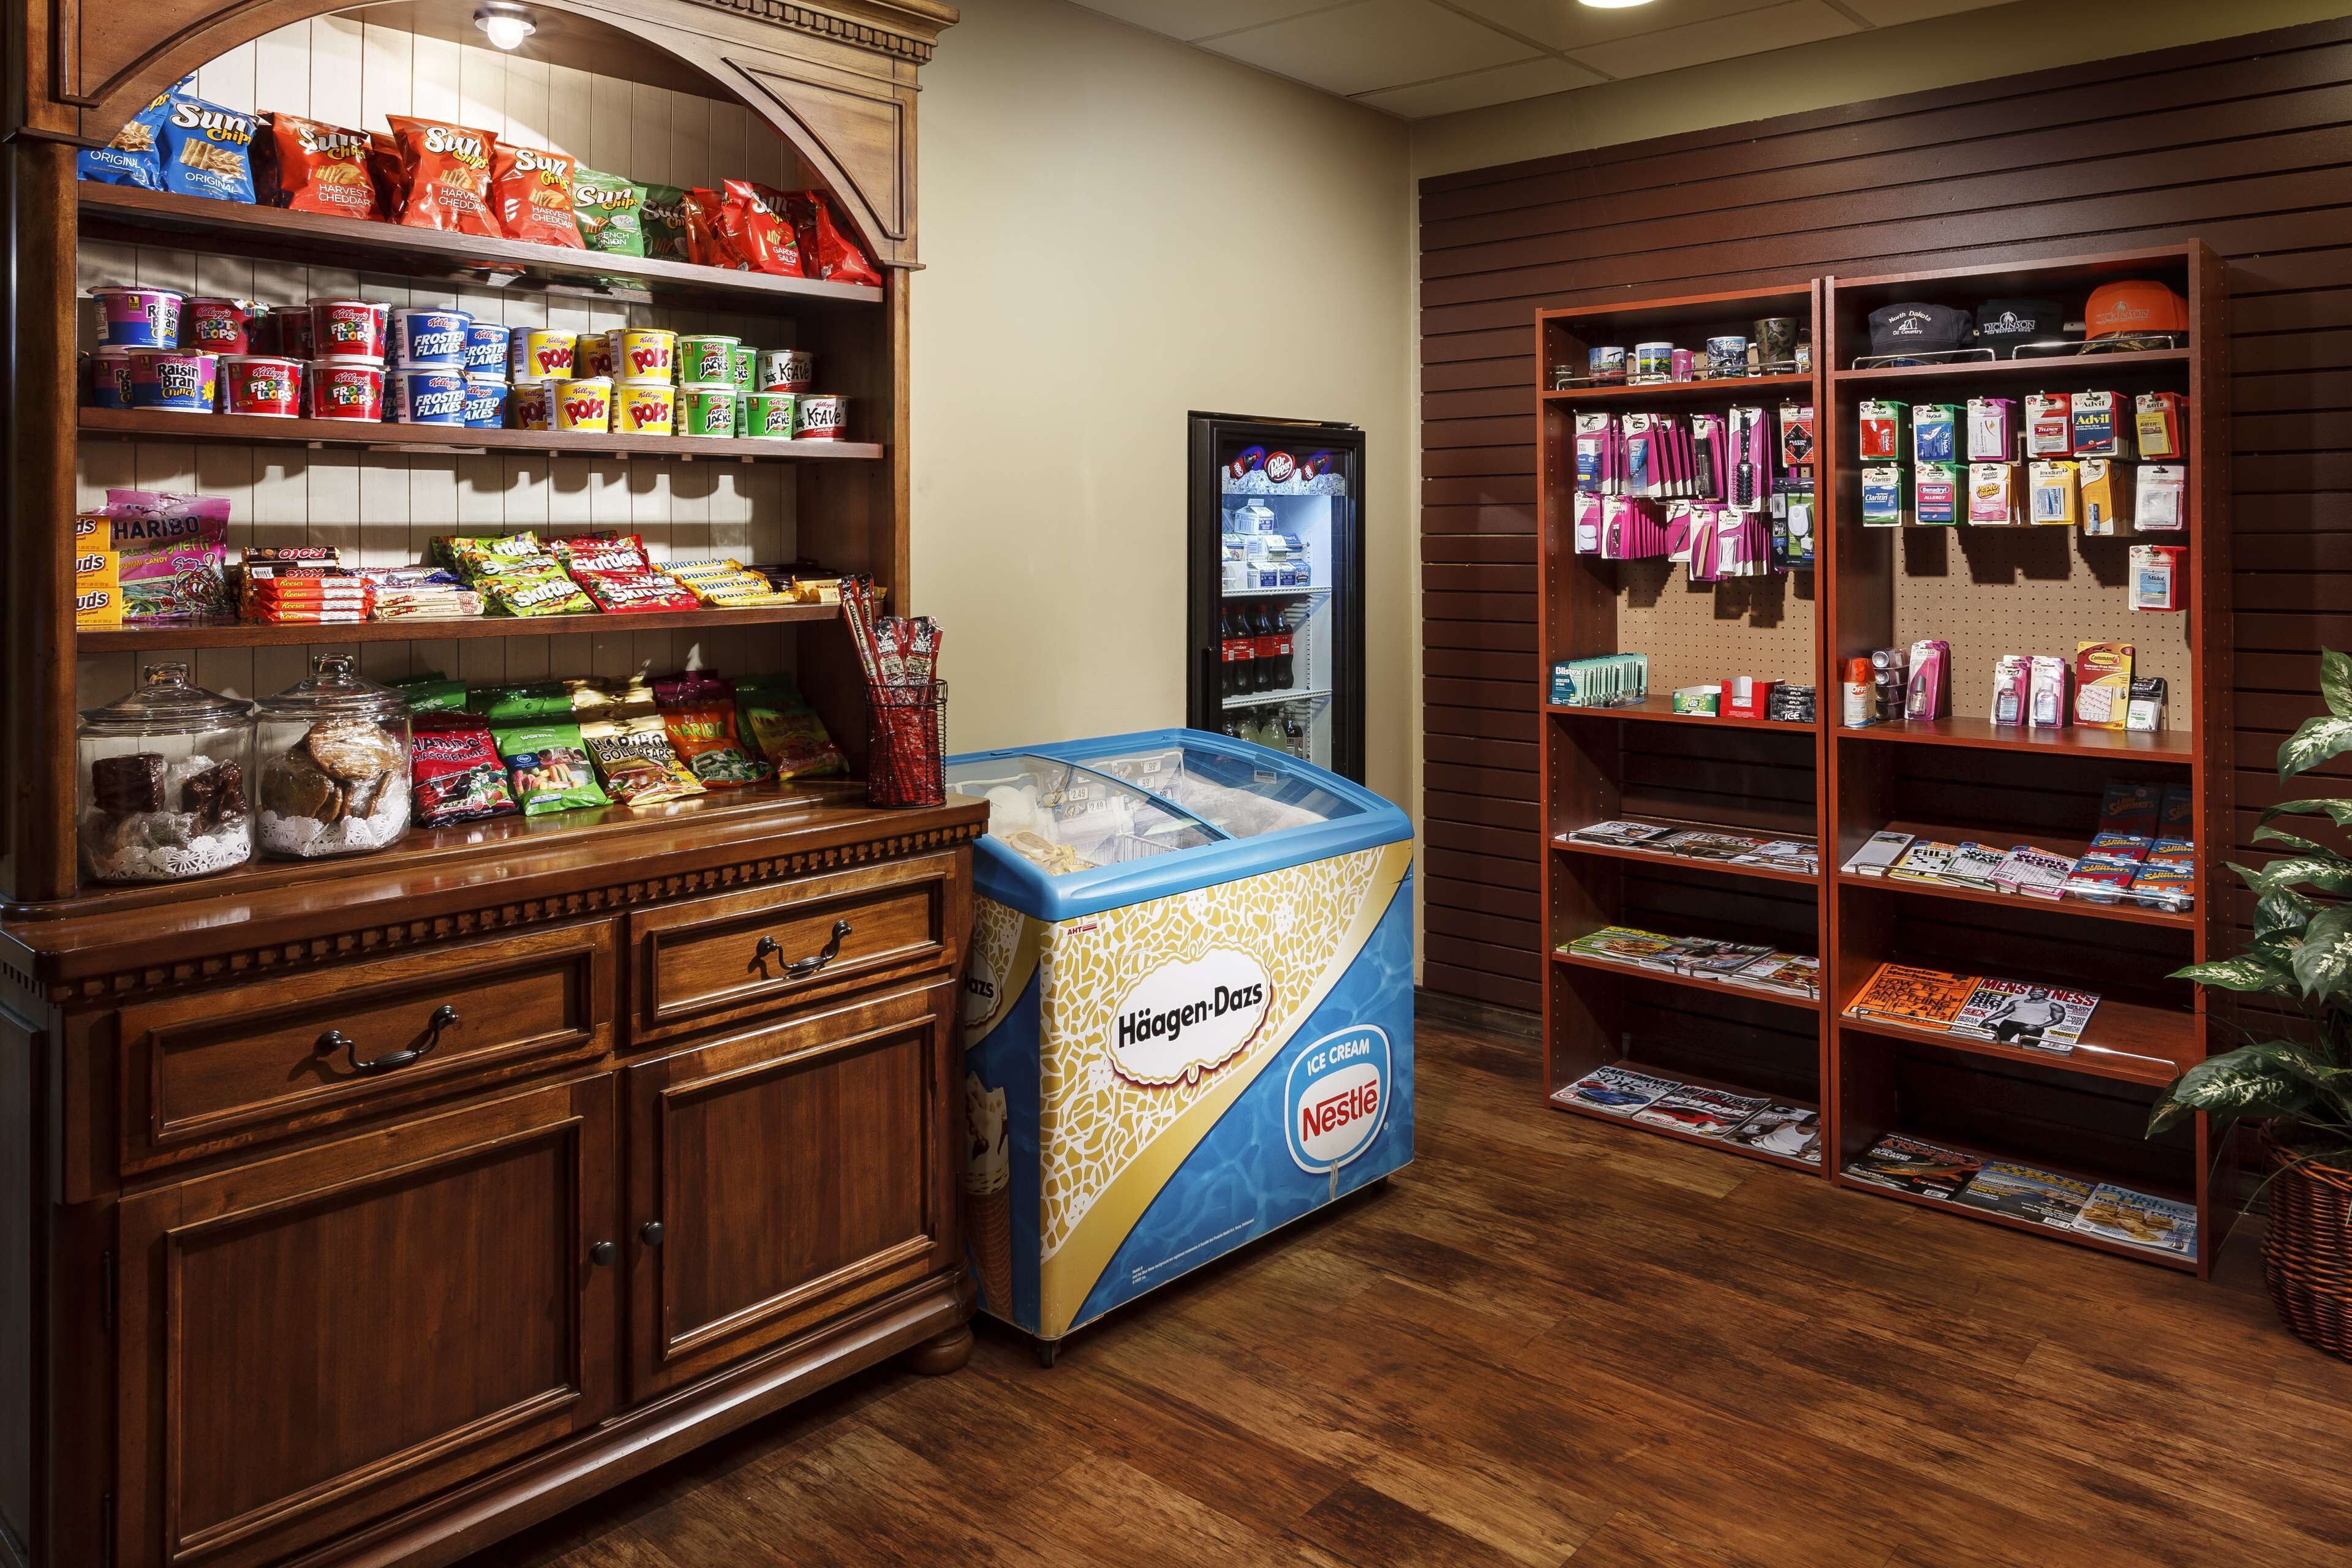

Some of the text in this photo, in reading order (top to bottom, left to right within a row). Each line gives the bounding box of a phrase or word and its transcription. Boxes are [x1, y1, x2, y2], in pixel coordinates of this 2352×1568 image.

[170, 102, 248, 133] Sun
[298, 126, 363, 153] Sun
[423, 126, 482, 154] Sun
[90, 151, 141, 168] ORIGINAL
[327, 145, 366, 160] Chips
[452, 150, 489, 170] Chips
[514, 149, 568, 177] Sun
[185, 172, 239, 194] ORIGINAL
[540, 170, 570, 191] Chips
[319, 183, 368, 197] HARVEST
[441, 187, 481, 203] HARVES
[574, 186, 633, 207] Sun
[318, 192, 371, 206] CHEDDAR
[439, 196, 488, 213] CHEDDAR
[601, 197, 639, 211] Chips
[750, 191, 788, 215] Sun
[532, 205, 573, 221] HARVEST
[531, 213, 573, 230] CHEDDAR
[594, 232, 630, 242] FRENCH
[597, 238, 627, 249] ONION
[773, 246, 798, 258] GARDEN
[197, 307, 232, 318] Kellogg's
[332, 309, 369, 321] Kellogg's
[1888, 310, 1932, 323] North Dakota
[195, 318, 237, 333] FROOT
[331, 320, 371, 334] FROOT
[428, 317, 460, 331] Kellogg's
[1983, 320, 2035, 333] DICKINSON
[200, 327, 238, 342] LOOPS
[337, 331, 372, 344] LOOPS
[413, 331, 466, 347] FROSTED
[474, 330, 504, 342] Kellogg's
[545, 337, 570, 346] Kellogg's
[639, 337, 663, 345] Kellogg's
[415, 342, 461, 358] FLAKES
[466, 343, 507, 356] FROSTED
[701, 343, 728, 353] Kellogg's
[164, 356, 196, 368] Kellogg's
[466, 353, 503, 368] FLAKES
[535, 347, 573, 375] POPS
[628, 347, 669, 375] POPS
[156, 363, 200, 380] Raisin
[252, 366, 290, 380] Kellogg's
[699, 360, 729, 380] JACKS
[162, 375, 196, 389] Bran
[334, 372, 371, 385] Kellogg's
[429, 377, 461, 390] Kellogg's
[162, 388, 195, 399] Crunch
[250, 380, 292, 394] FROOT
[333, 385, 372, 398] FROOT
[573, 387, 598, 396] Kellogg's
[257, 390, 293, 403] LOOPS
[339, 395, 374, 407] LOOPS
[415, 390, 466, 407] FROSTED
[638, 391, 662, 401] Kellogg's
[708, 396, 731, 405] Kellogg's
[417, 400, 461, 417] FLAKES
[465, 397, 500, 410] OSTED
[767, 399, 790, 408] Kellogg's
[465, 408, 496, 421] AKES
[562, 398, 605, 428] POPS
[627, 402, 669, 431] POPS
[2076, 413, 2110, 425] Advil
[705, 413, 732, 434] JACKS
[764, 416, 790, 435] JACKS
[1268, 459, 1292, 478] Pepper
[1276, 456, 1286, 467] Dr
[1865, 492, 1888, 501] Claritin
[1978, 489, 2000, 498] Bismol
[113, 516, 199, 540] HARIBO
[144, 556, 168, 565] CANDY
[571, 551, 643, 571] Skittles
[283, 589, 307, 599] Reese's
[513, 581, 582, 608] Skittles
[281, 601, 305, 610] Reese's
[280, 611, 304, 620] Reese's
[1555, 666, 1582, 677] Blistex
[1851, 685, 1867, 693] OFF!
[1784, 711, 1801, 720] ICE
[666, 720, 725, 737] HARIBO
[412, 736, 481, 752] HARIBO
[590, 733, 666, 752] HARIBO
[412, 747, 491, 763] RASPBERRIES
[2015, 858, 2070, 872] SEEKS
[2016, 853, 2068, 867] WORD
[1067, 926, 1082, 936] AHT
[1887, 970, 1954, 985] Mechanics
[1890, 965, 1941, 977] Popular
[1874, 983, 1917, 995] MAKE
[1879, 978, 1940, 992] HOW TO
[1980, 979, 2030, 995] MEN'S
[1970, 997, 2004, 1008] BIG
[1973, 990, 2008, 1002] GET
[1118, 982, 1263, 1049] Häagen-Dazs
[1306, 1038, 1370, 1077] ICE CREAM
[1599, 1067, 1680, 1089] CAR DRIVER
[1660, 1095, 1710, 1109] NEW
[1878, 1137, 1967, 1163] ANGLER
